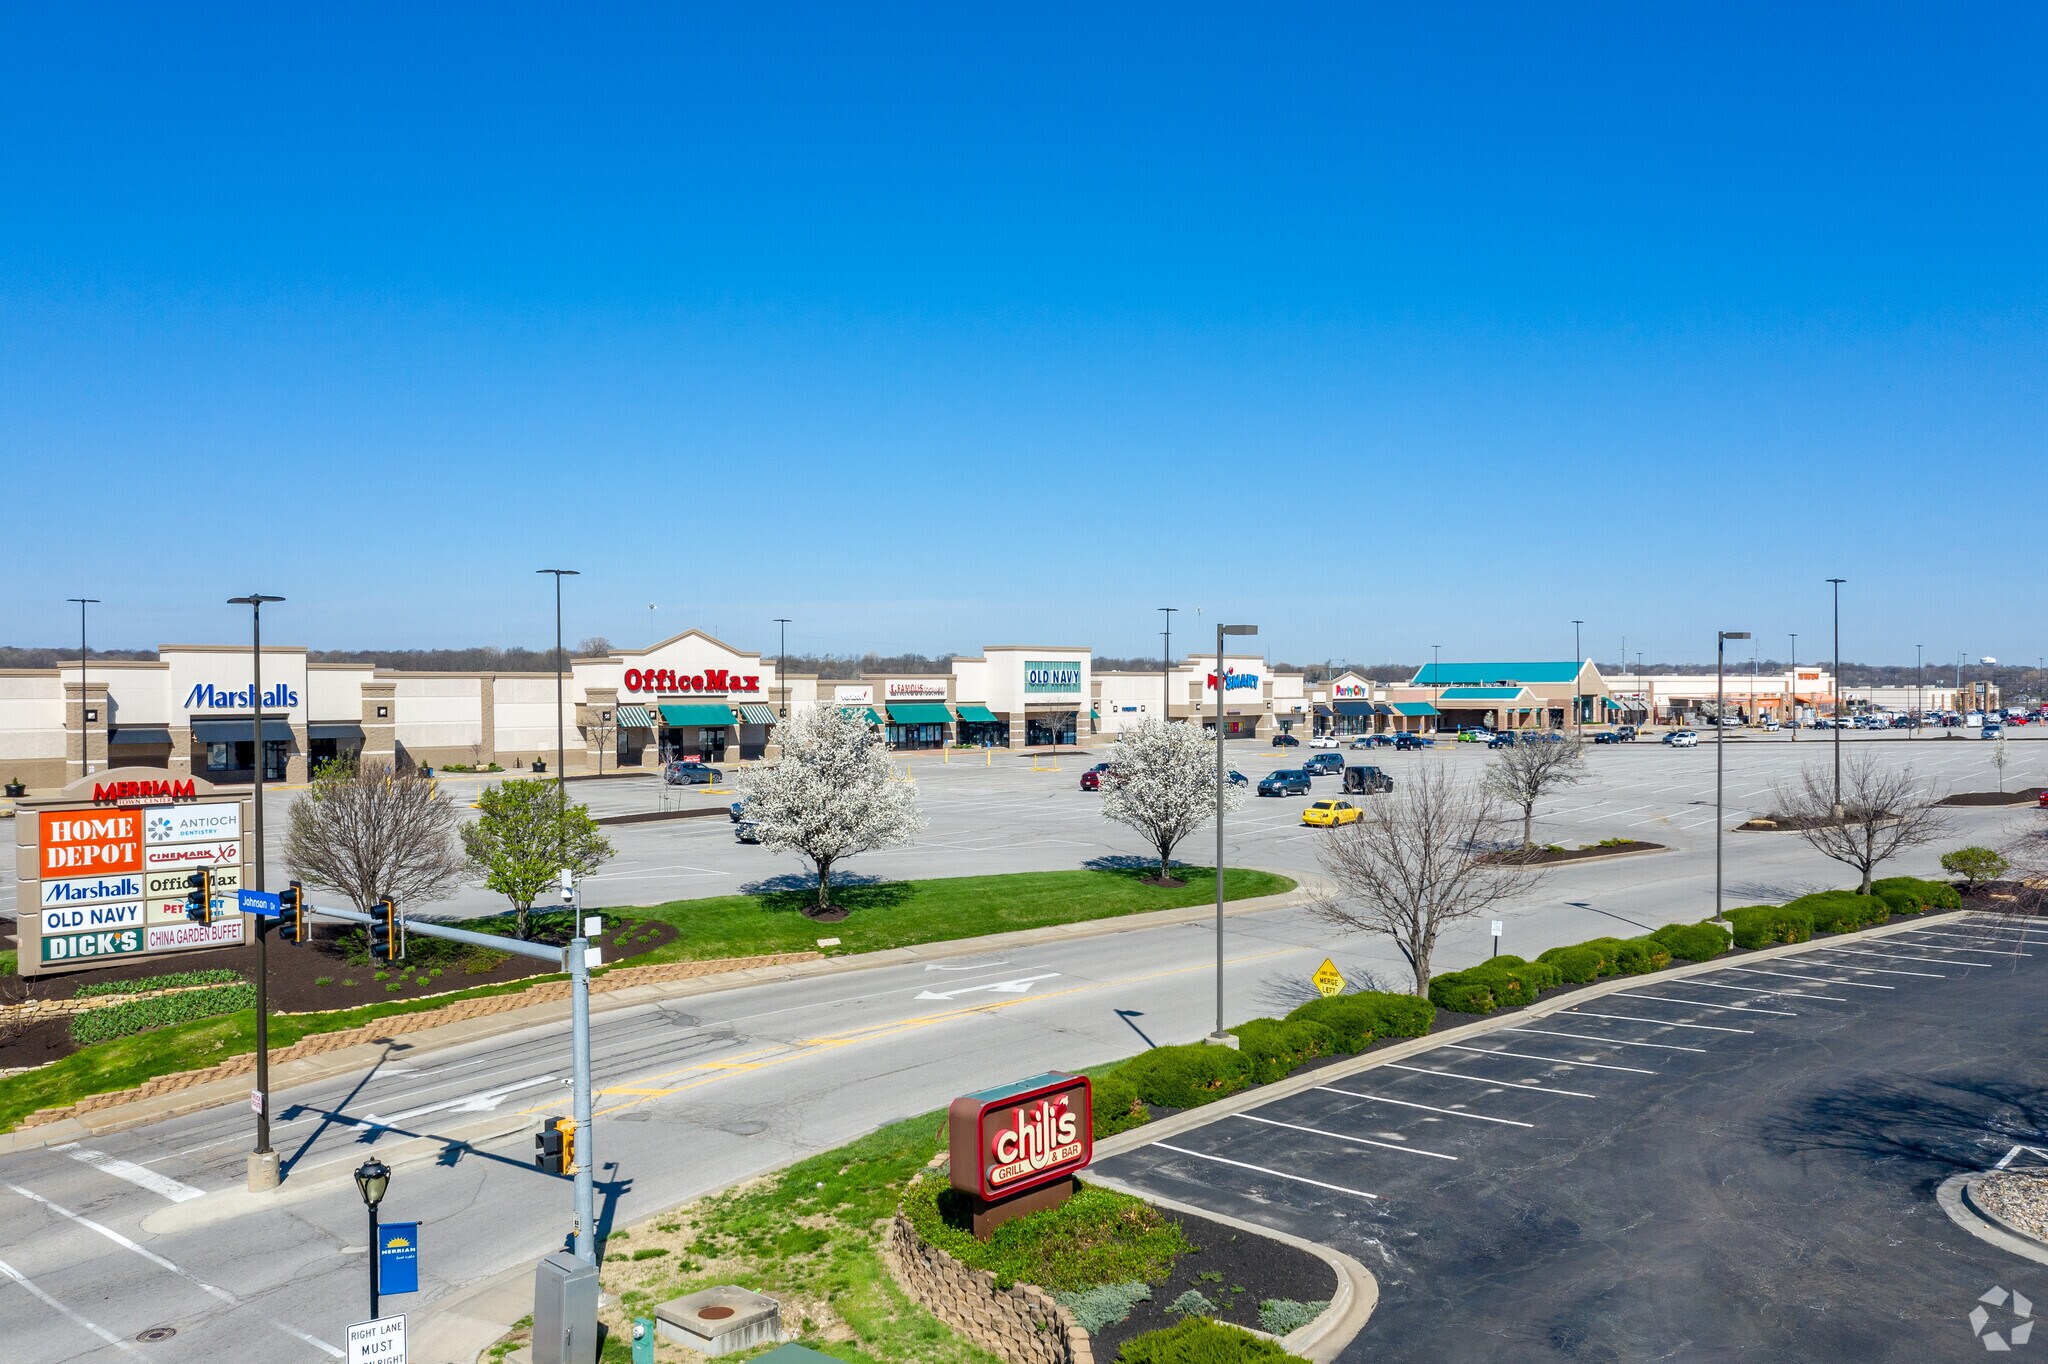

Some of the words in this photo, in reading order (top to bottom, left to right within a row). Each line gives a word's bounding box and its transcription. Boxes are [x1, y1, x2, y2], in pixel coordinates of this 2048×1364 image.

[624, 668, 759, 691] OfficeMax
[1029, 670, 1049, 684] OLD
[1052, 670, 1080, 684] NAVY
[184, 683, 298, 708] Marshalls
[1336, 685, 1353, 697] Party
[1354, 685, 1366, 697] City
[93, 779, 196, 801] MERRIAM
[50, 817, 133, 842] HOME
[180, 815, 237, 828] ANTIOCH
[47, 842, 137, 868] DEPOT
[149, 850, 215, 863] CINEMARK
[213, 844, 237, 864] XD
[46, 878, 139, 902] Marshalls
[242, 895, 267, 909] Johnson
[270, 902, 276, 910] Dr
[47, 910, 84, 929] OLD
[91, 905, 138, 924] NAVY
[50, 931, 137, 959] DICK'S
[149, 931, 176, 947] CHINA
[176, 926, 210, 945] GARDEN
[212, 923, 242, 940] BUFFET
[1319, 977, 1338, 986] MERGE
[998, 1163, 1024, 1180] GRILL
[1051, 1152, 1058, 1162] &
[1061, 1145, 1079, 1159] BAR
[381, 1247, 416, 1255] MERRIAM
[351, 1327, 376, 1341] RIGHT
[380, 1321, 403, 1335] LANE
[361, 1339, 393, 1357] MUST
